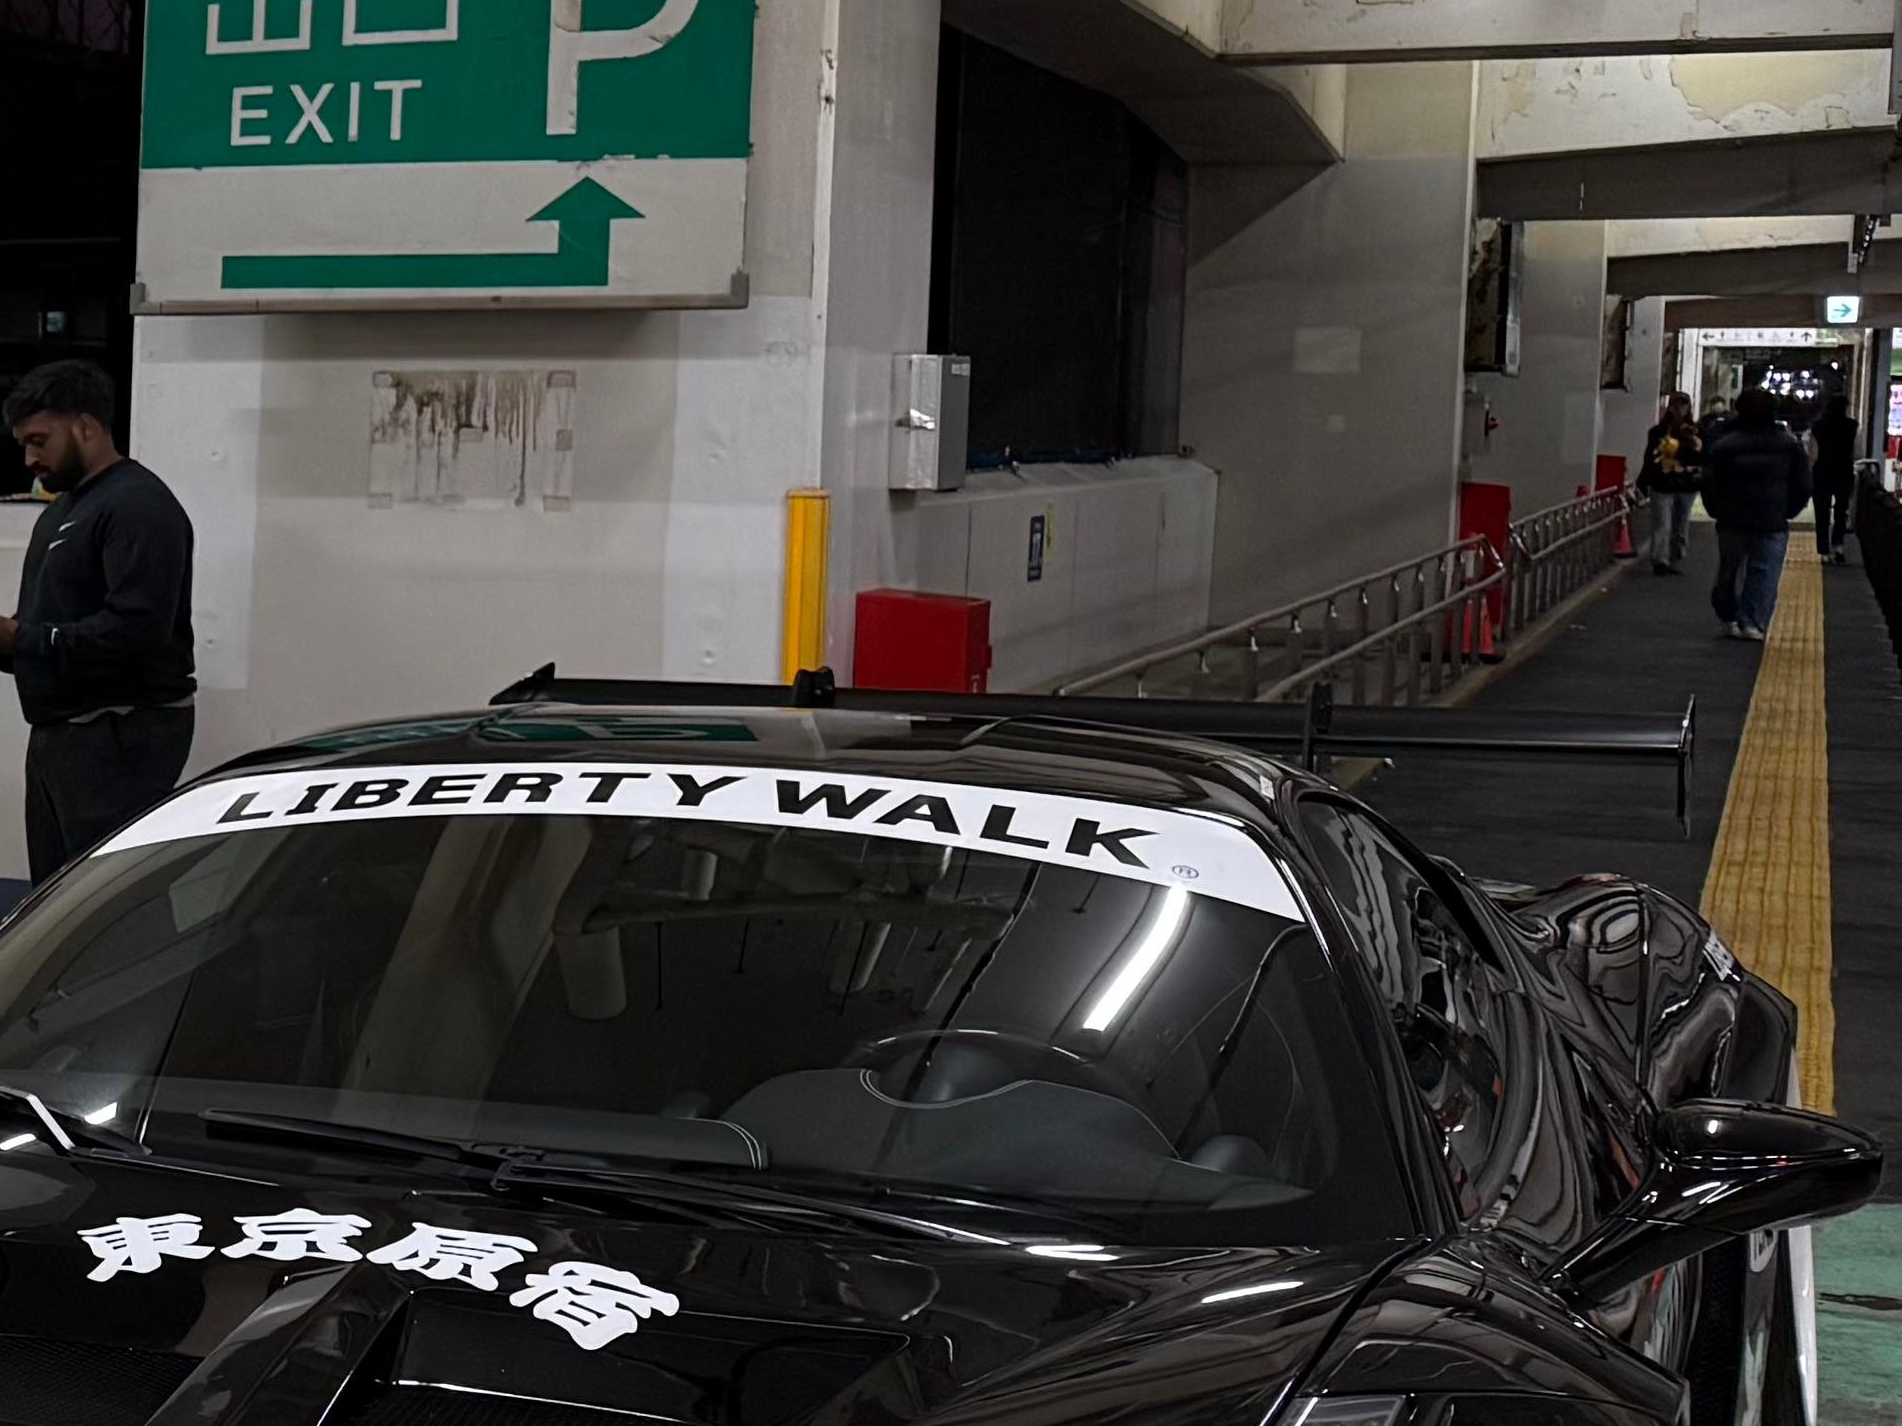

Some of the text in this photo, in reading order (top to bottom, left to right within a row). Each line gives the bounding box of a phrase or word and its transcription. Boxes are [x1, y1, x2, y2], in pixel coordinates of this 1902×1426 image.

[230, 79, 422, 146] EXIT
[216, 772, 747, 825] LIBERTY
[77, 1207, 680, 1352] 東京原宿
